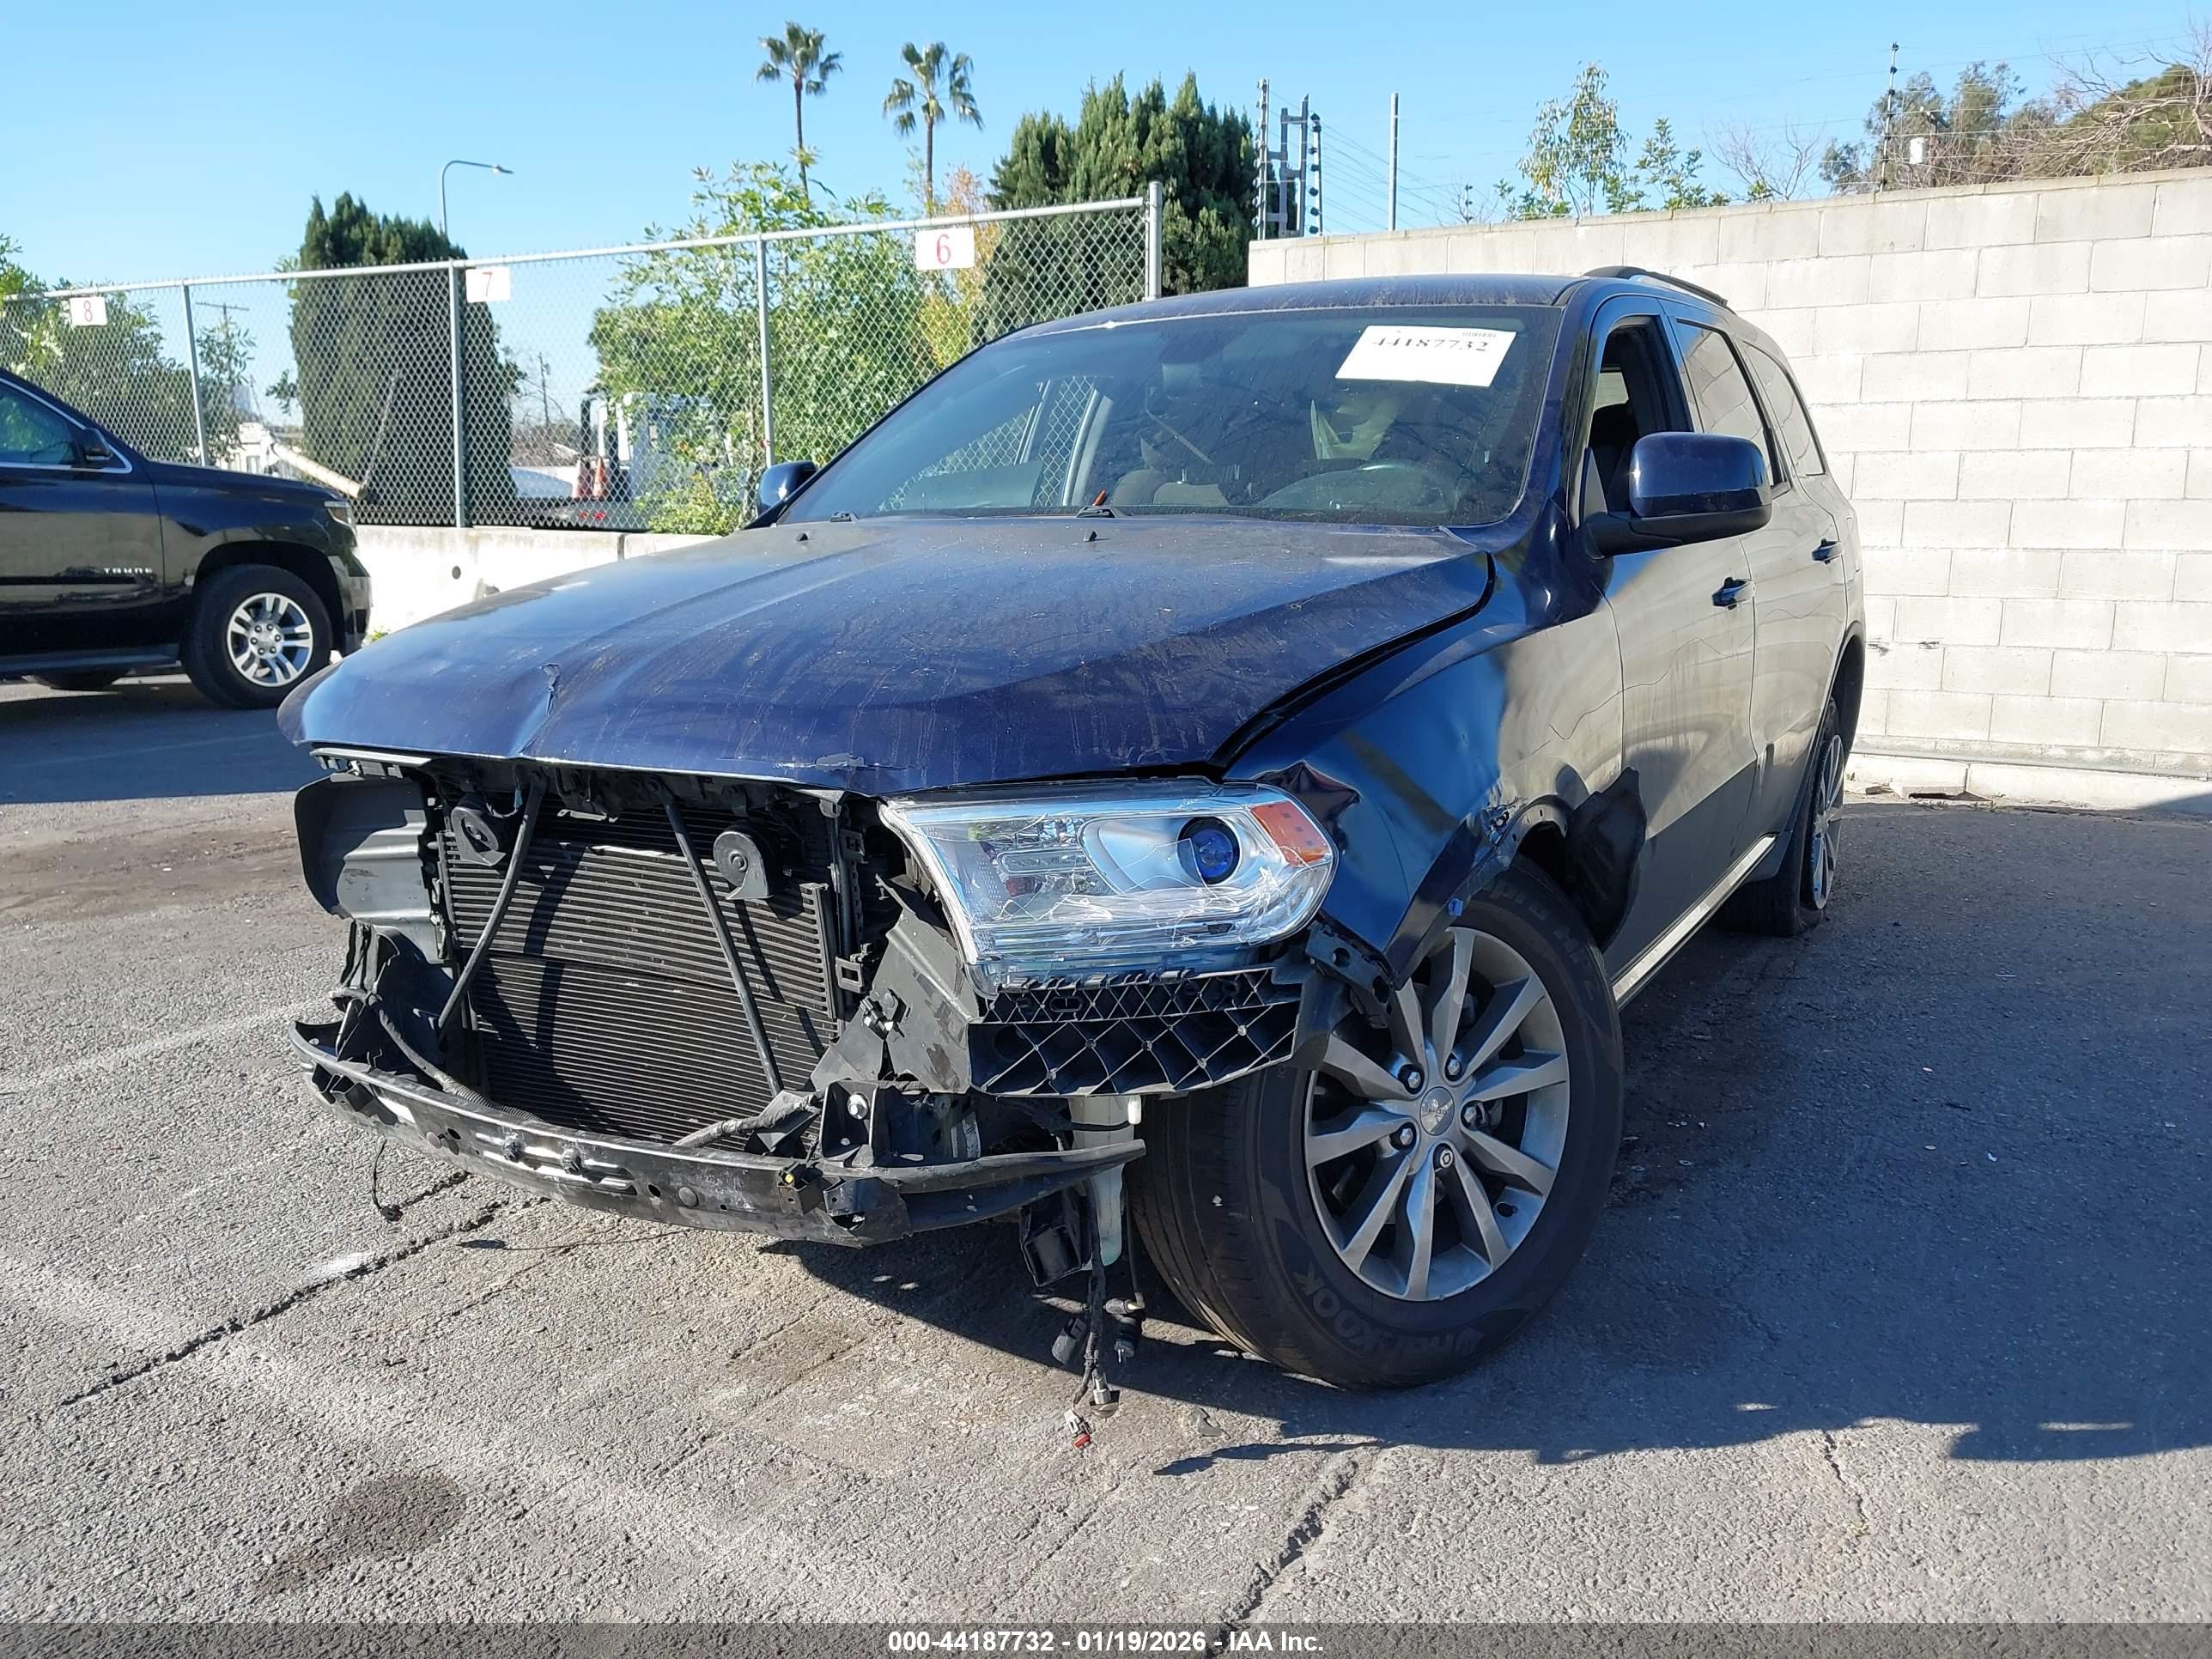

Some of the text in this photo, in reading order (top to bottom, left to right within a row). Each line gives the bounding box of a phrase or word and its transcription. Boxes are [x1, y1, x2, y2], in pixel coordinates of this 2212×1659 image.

[936, 233, 951, 265] 6
[482, 271, 493, 297] 7
[83, 300, 93, 322] 8
[1372, 337, 1490, 353] 44187732
